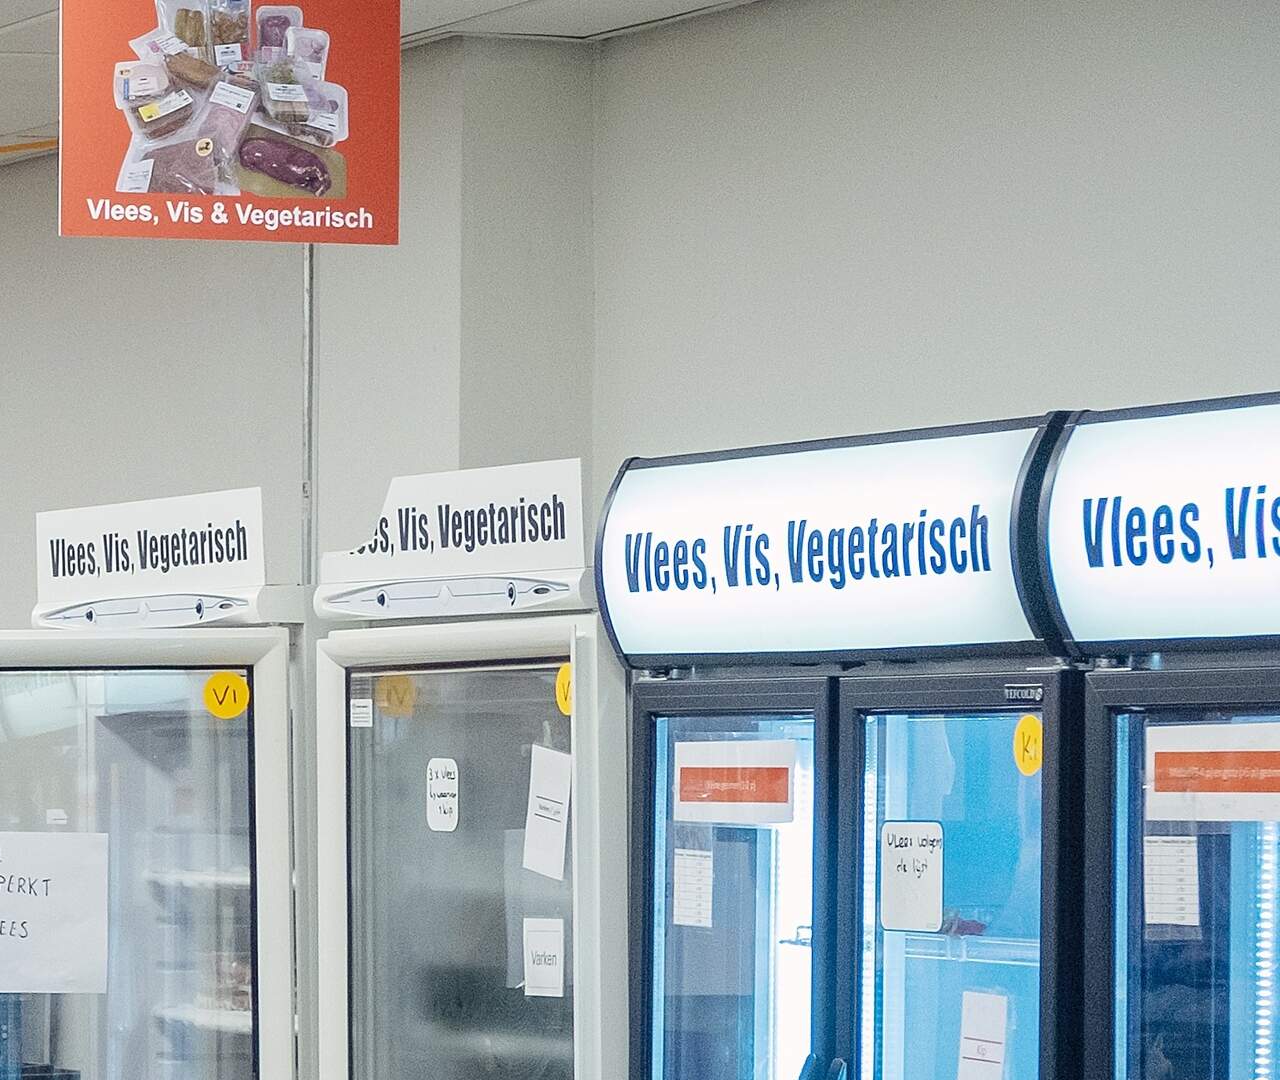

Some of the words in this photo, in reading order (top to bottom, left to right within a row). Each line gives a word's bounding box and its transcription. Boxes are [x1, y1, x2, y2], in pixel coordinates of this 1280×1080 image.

[86, 198, 159, 226] Vlees,
[166, 200, 203, 223] Vis
[210, 201, 229, 224] &
[235, 203, 373, 231] Vegetarisch
[50, 538, 101, 578] Vlees,
[103, 532, 135, 575] Vis,
[137, 519, 248, 574] Vegetarisch
[397, 506, 434, 554] Vis,
[437, 494, 566, 553] Vegetarisch
[625, 532, 717, 594] Vlees,
[723, 524, 780, 592] Vis,
[787, 504, 991, 590] Vegetarisch
[1083, 496, 1214, 569] Vlees,
[531, 950, 557, 967] Varken
